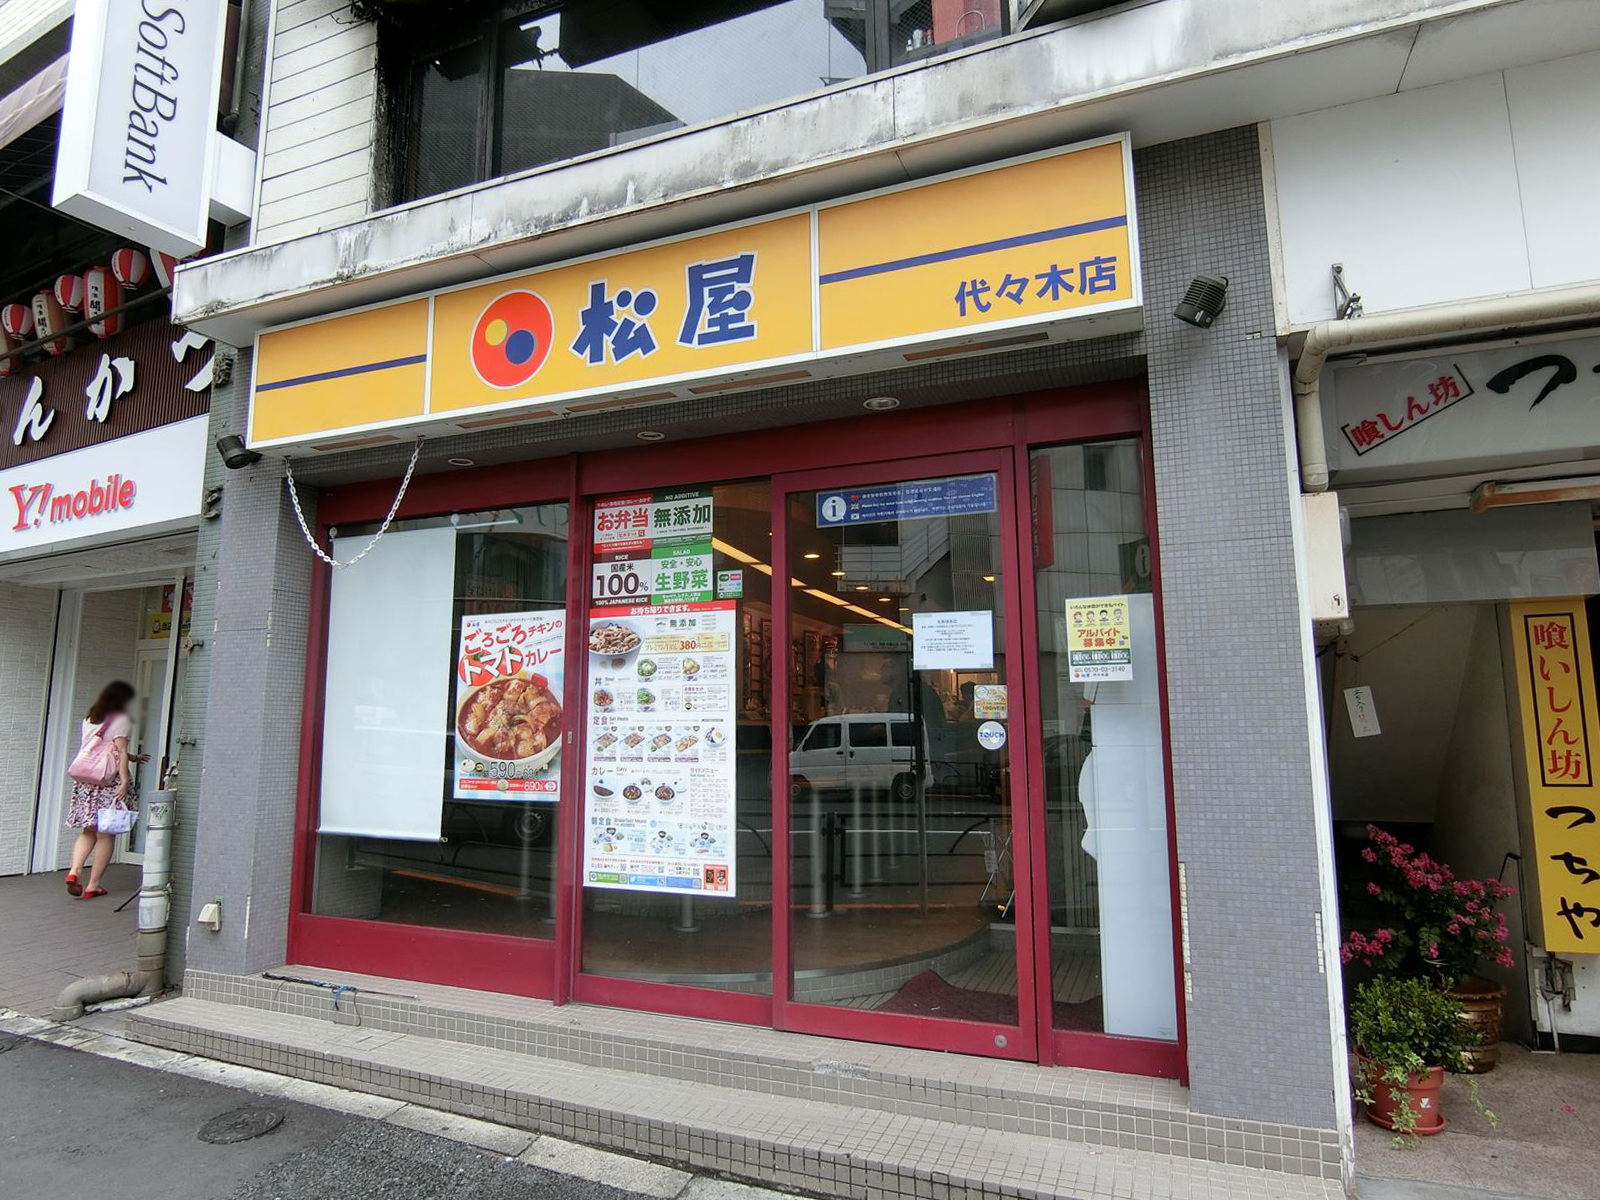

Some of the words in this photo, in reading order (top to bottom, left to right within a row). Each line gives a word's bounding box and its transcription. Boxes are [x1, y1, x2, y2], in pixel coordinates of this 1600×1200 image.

[122, 0, 186, 193] SoftBank
[954, 256, 1118, 317] 代々木店
[569, 251, 758, 366] 松屋
[1349, 375, 1461, 448] 喰しん坊
[8, 473, 137, 531] Y!mobile
[597, 508, 649, 531] お弁当
[653, 504, 711, 528] 無添加
[610, 562, 635, 573] 国産米
[660, 557, 703, 569] 安全・安心
[655, 568, 709, 592] 生野菜
[1077, 627, 1120, 639] アルバイト
[1083, 637, 1116, 648] 募集中
[1534, 620, 1582, 781] 喰いしん坊
[591, 766, 615, 776] カレー
[1544, 805, 1600, 941] つちや
